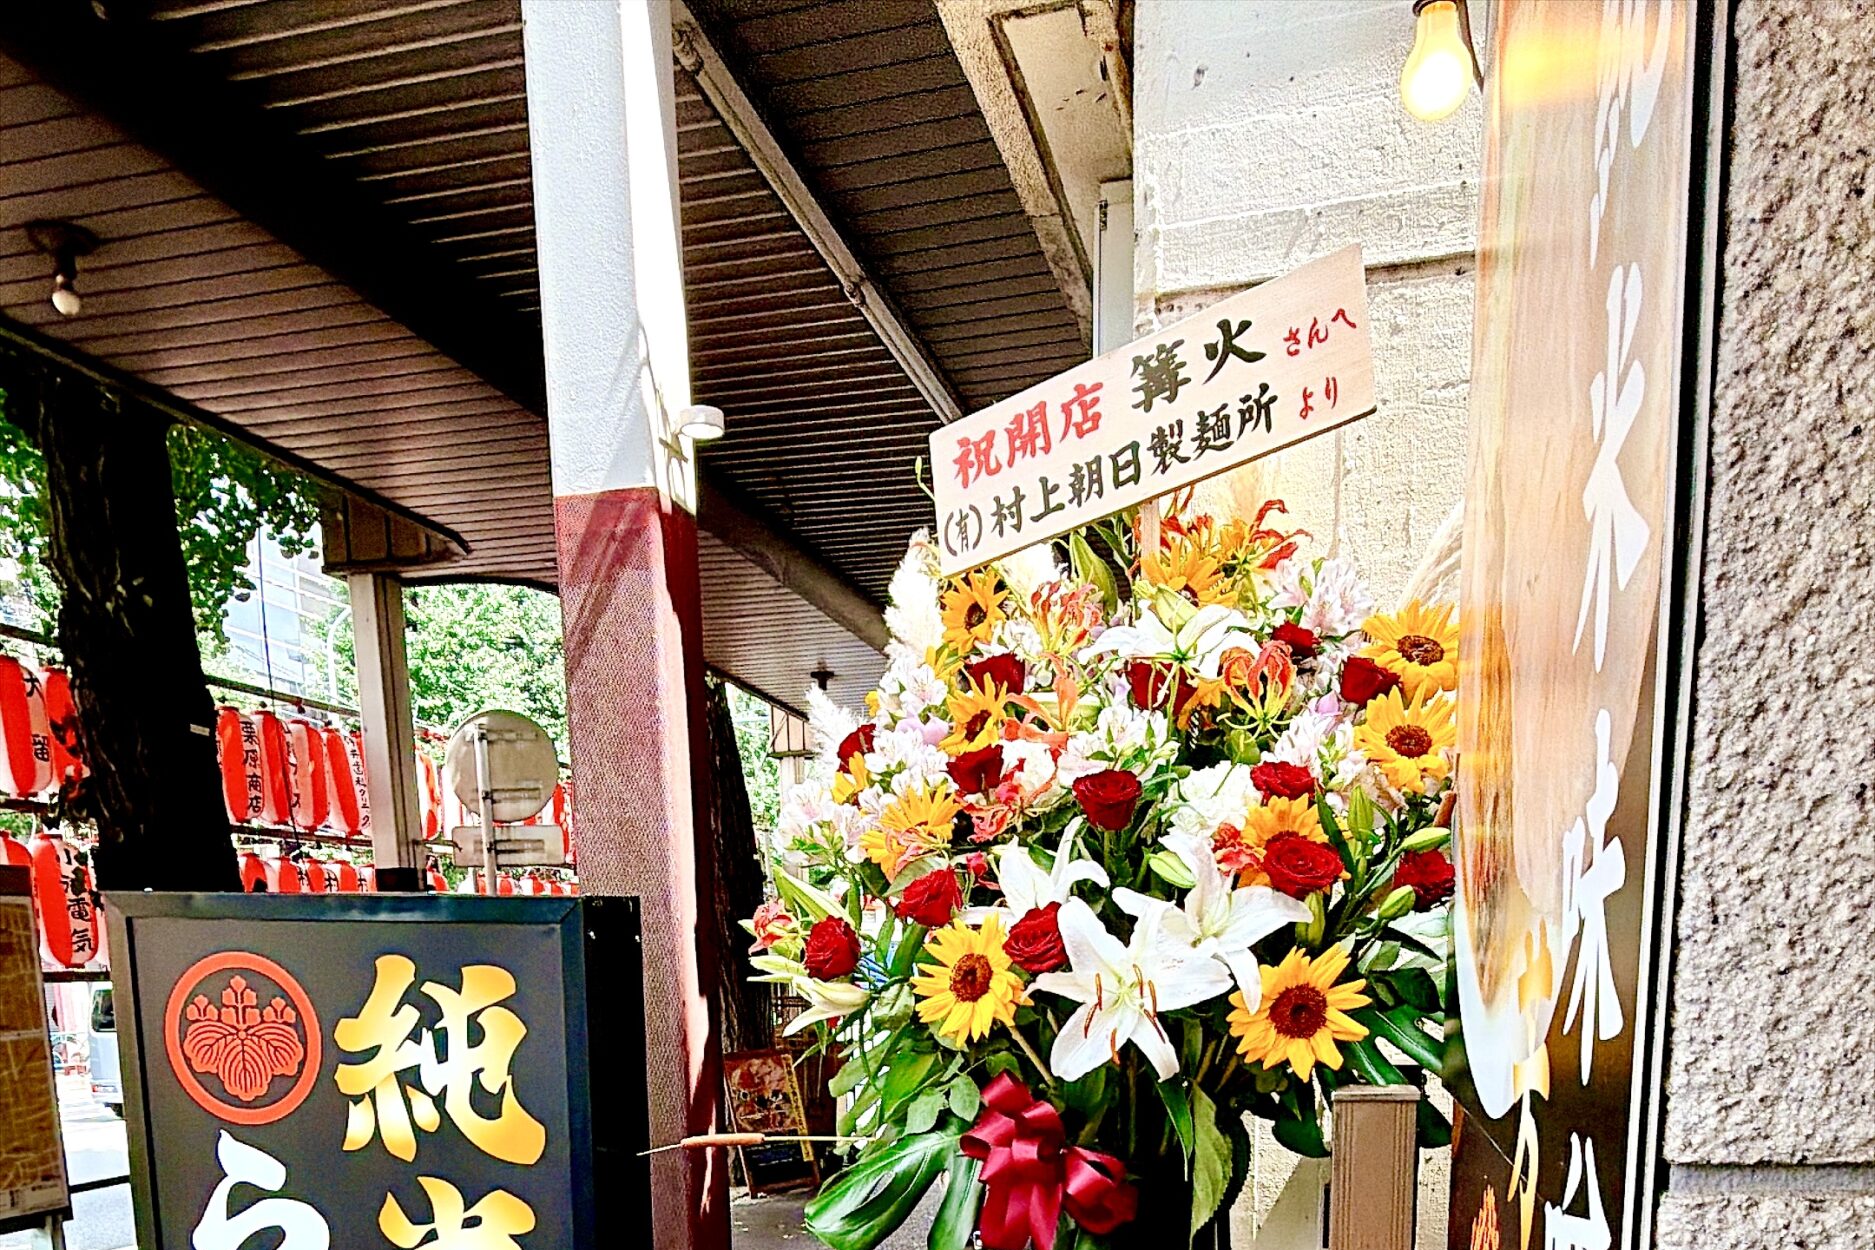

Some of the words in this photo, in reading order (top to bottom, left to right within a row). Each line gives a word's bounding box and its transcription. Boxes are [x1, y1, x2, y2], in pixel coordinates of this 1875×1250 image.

[952, 381, 1105, 489] 祝開店
[1130, 317, 1267, 413] 篝火
[1282, 307, 1357, 357] さんへ
[1298, 376, 1339, 419] より
